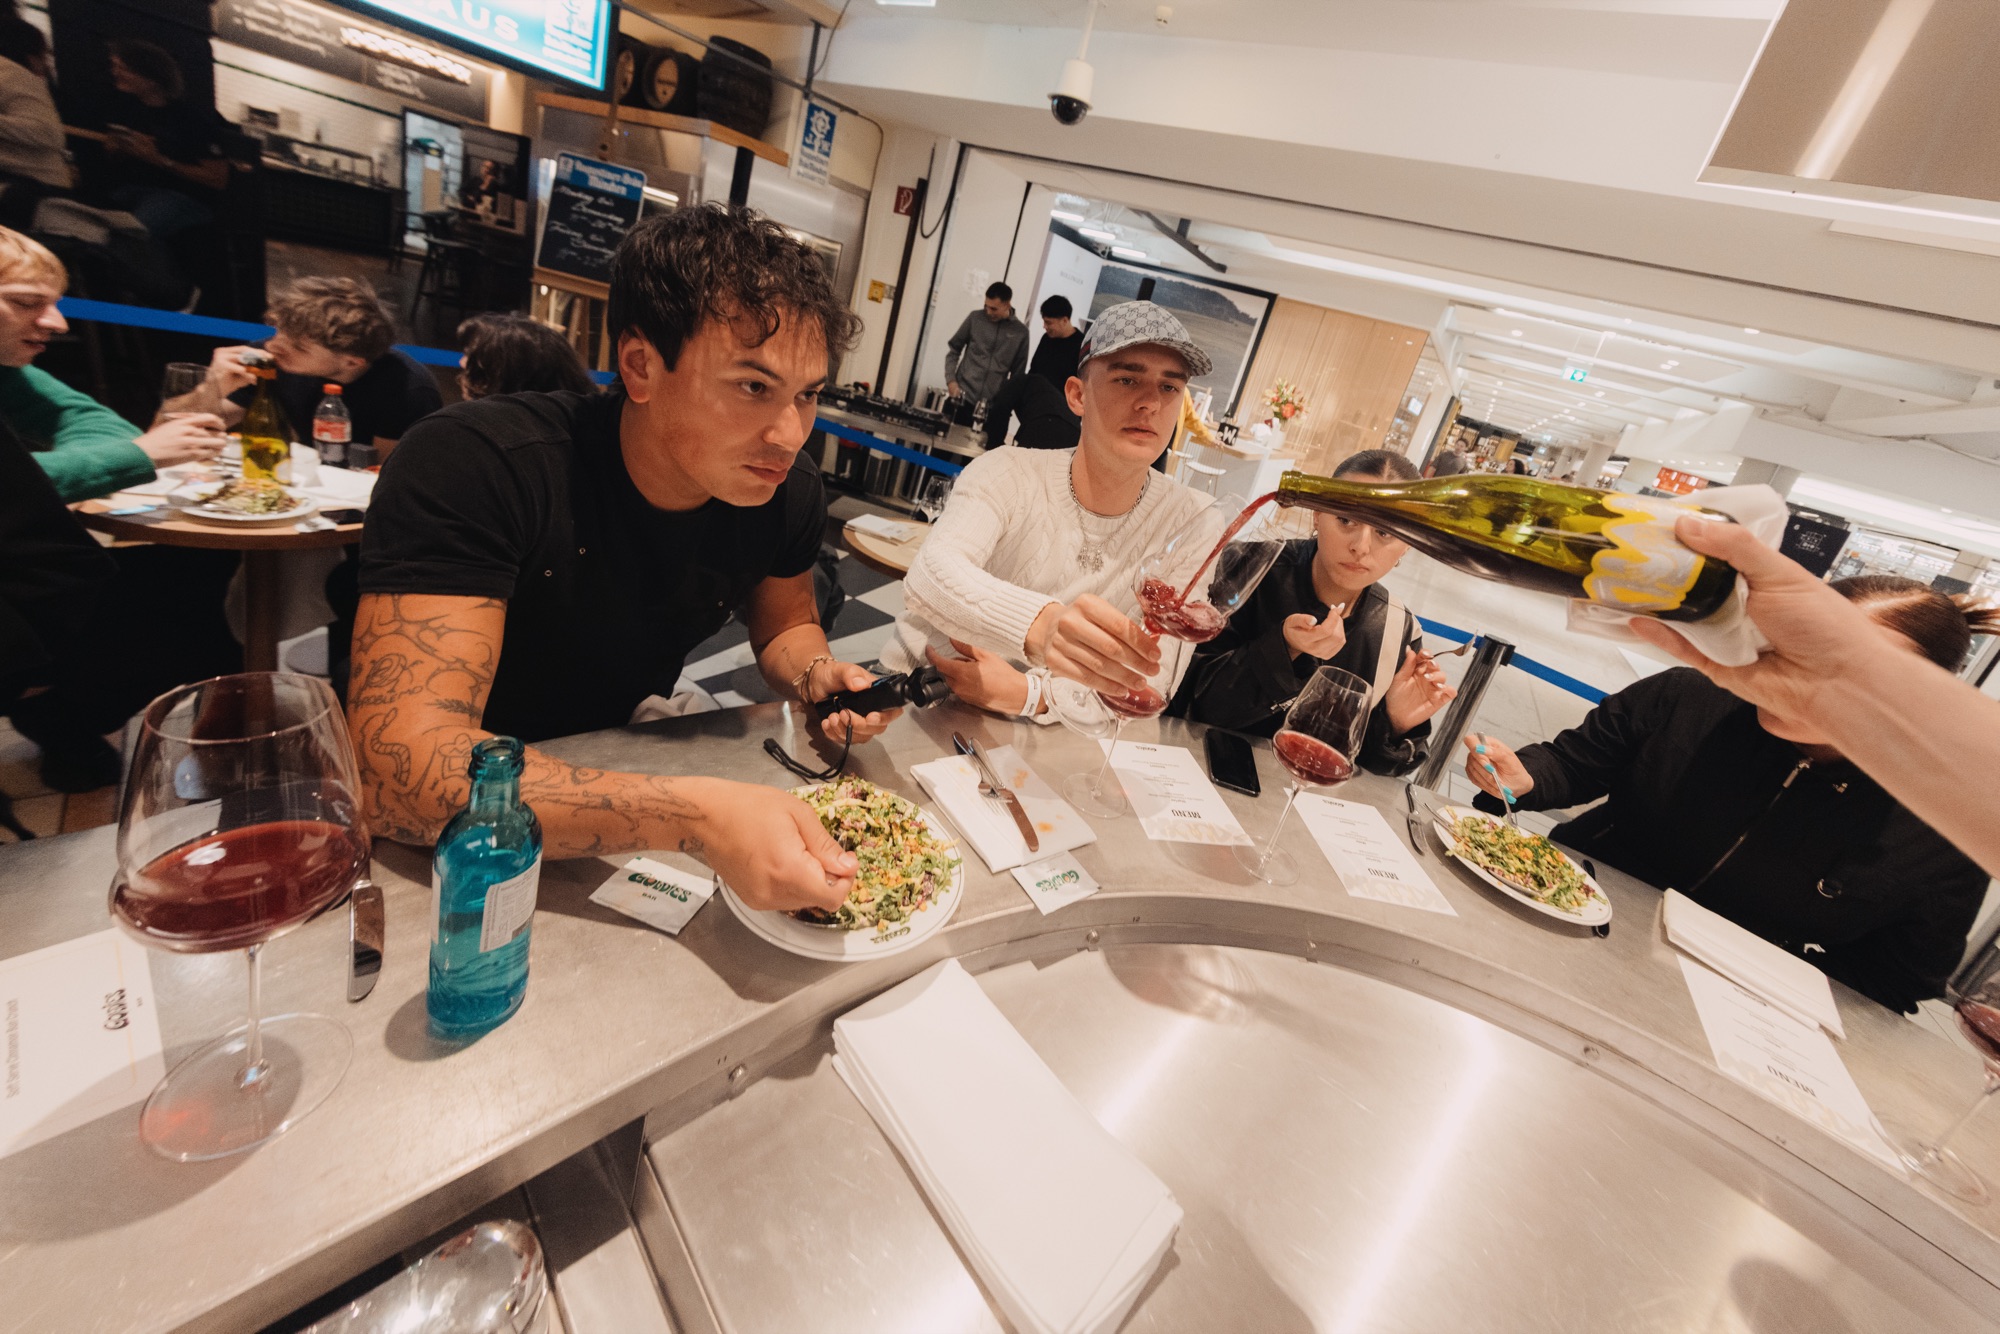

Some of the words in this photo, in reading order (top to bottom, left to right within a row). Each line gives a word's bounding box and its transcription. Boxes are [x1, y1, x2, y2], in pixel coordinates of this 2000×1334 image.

[413, 0, 519, 42] AUS
[1171, 808, 1202, 819] MENU
[1367, 867, 1400, 881] MENU
[1766, 1064, 1817, 1098] MENU
